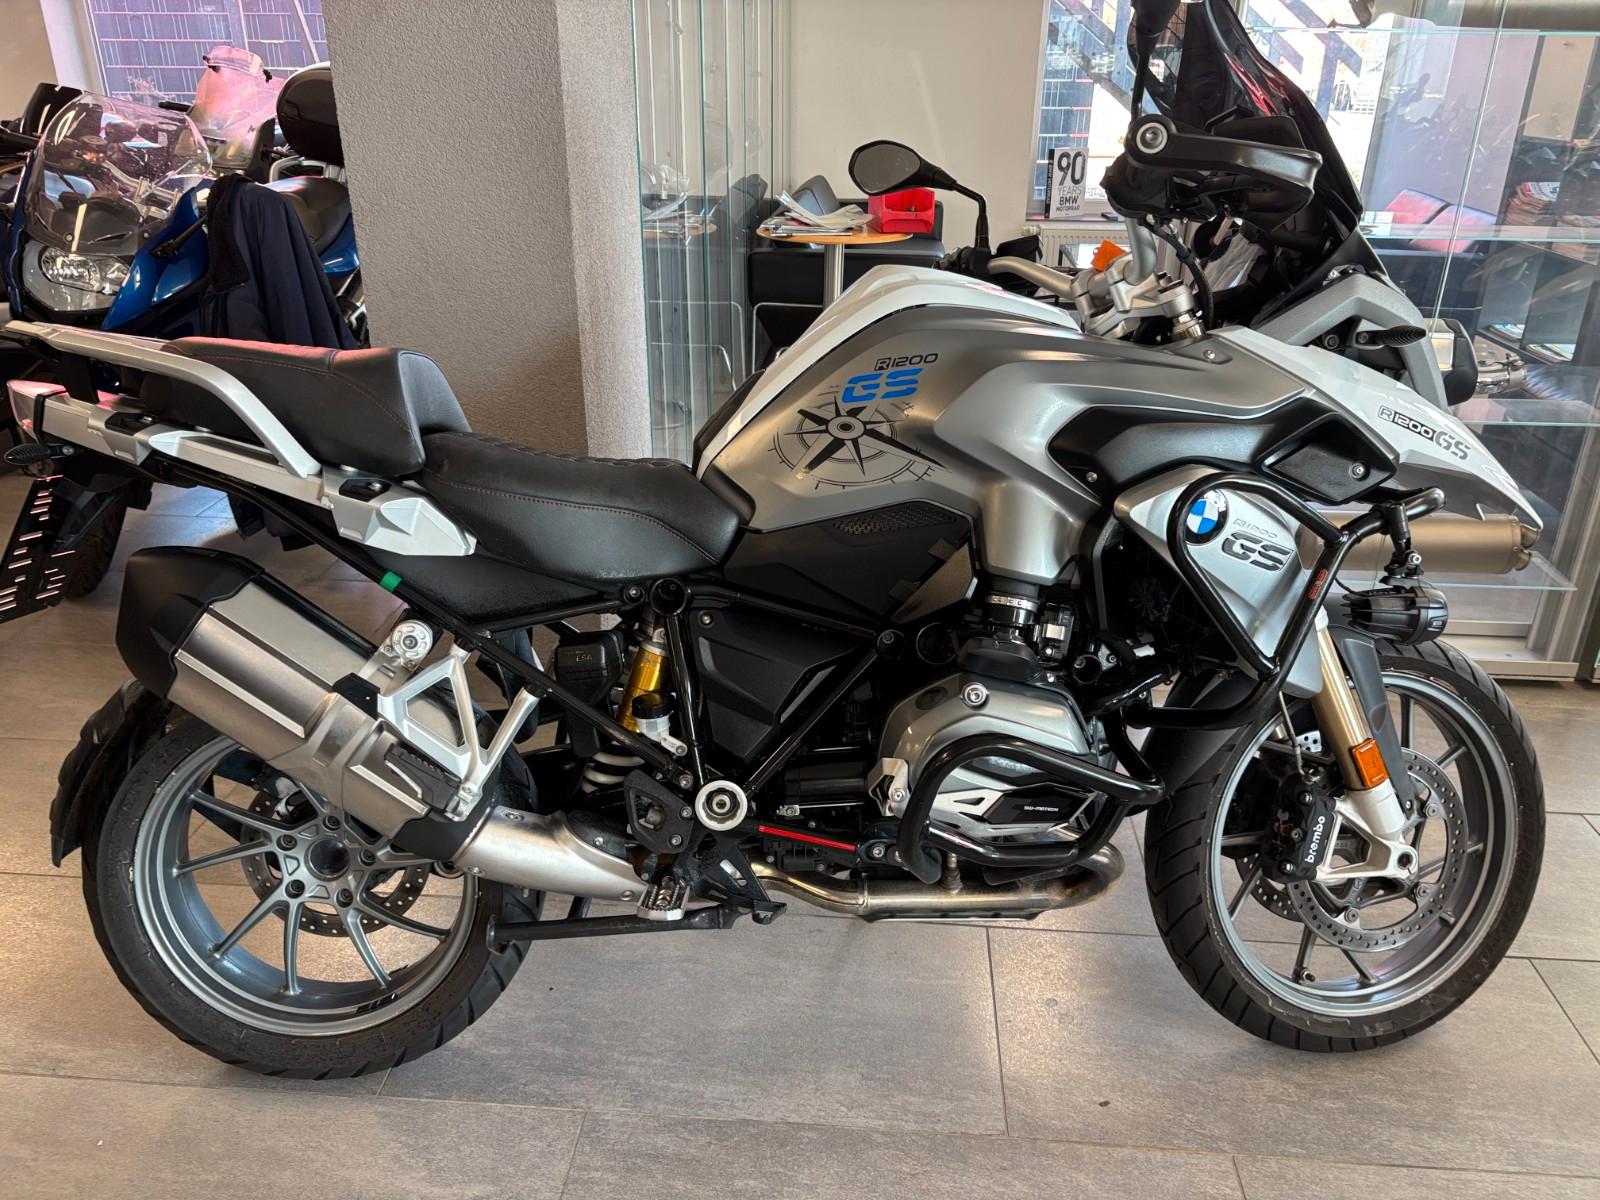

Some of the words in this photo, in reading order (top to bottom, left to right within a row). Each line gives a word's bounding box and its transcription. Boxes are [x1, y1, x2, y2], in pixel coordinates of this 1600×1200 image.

[1057, 151, 1086, 186] 90
[1057, 186, 1082, 195] YEARS
[1060, 196, 1079, 206] BMW
[874, 352, 938, 371] R1200
[842, 367, 925, 404] GS
[1221, 532, 1291, 571] GS
[1304, 815, 1325, 863] brembo
